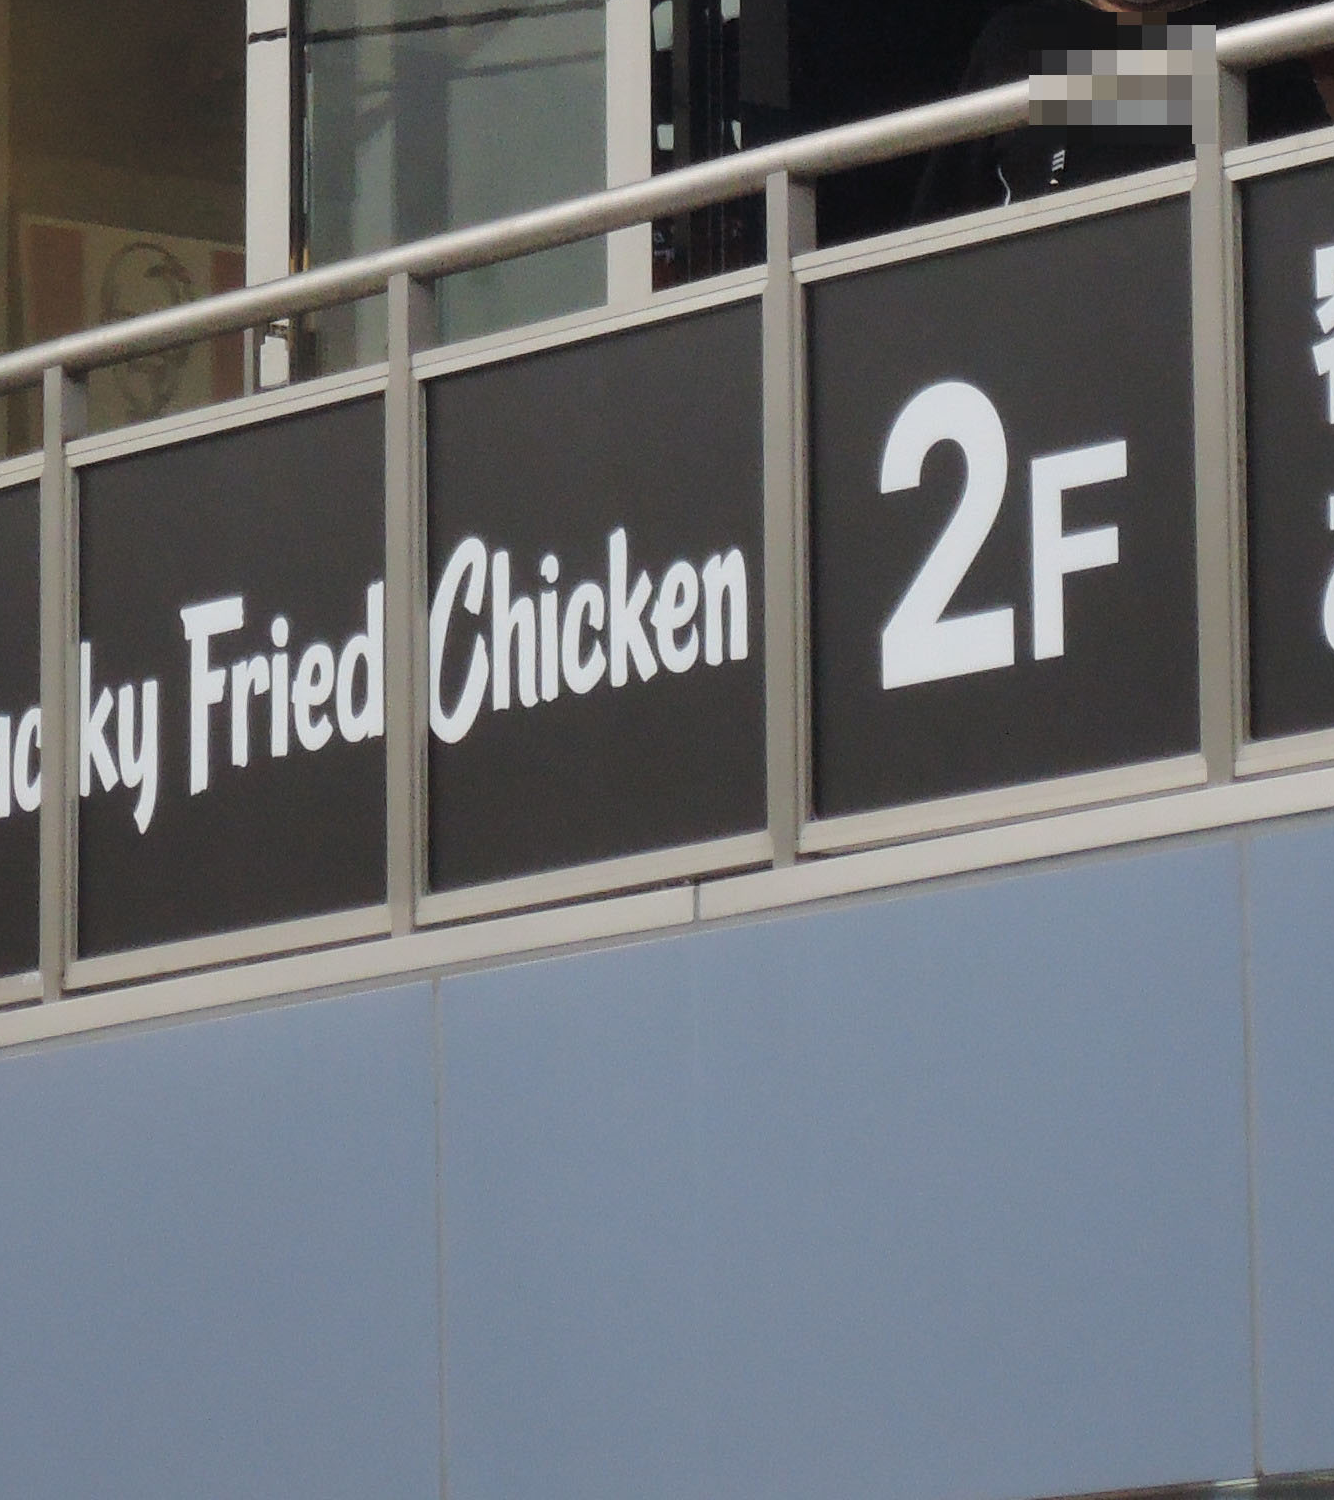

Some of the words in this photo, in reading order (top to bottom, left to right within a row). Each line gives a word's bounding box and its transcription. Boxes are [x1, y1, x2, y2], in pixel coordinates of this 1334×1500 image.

[179, 580, 385, 797] Fried
[428, 526, 749, 745] Chicken
[879, 380, 1129, 691] 2F
